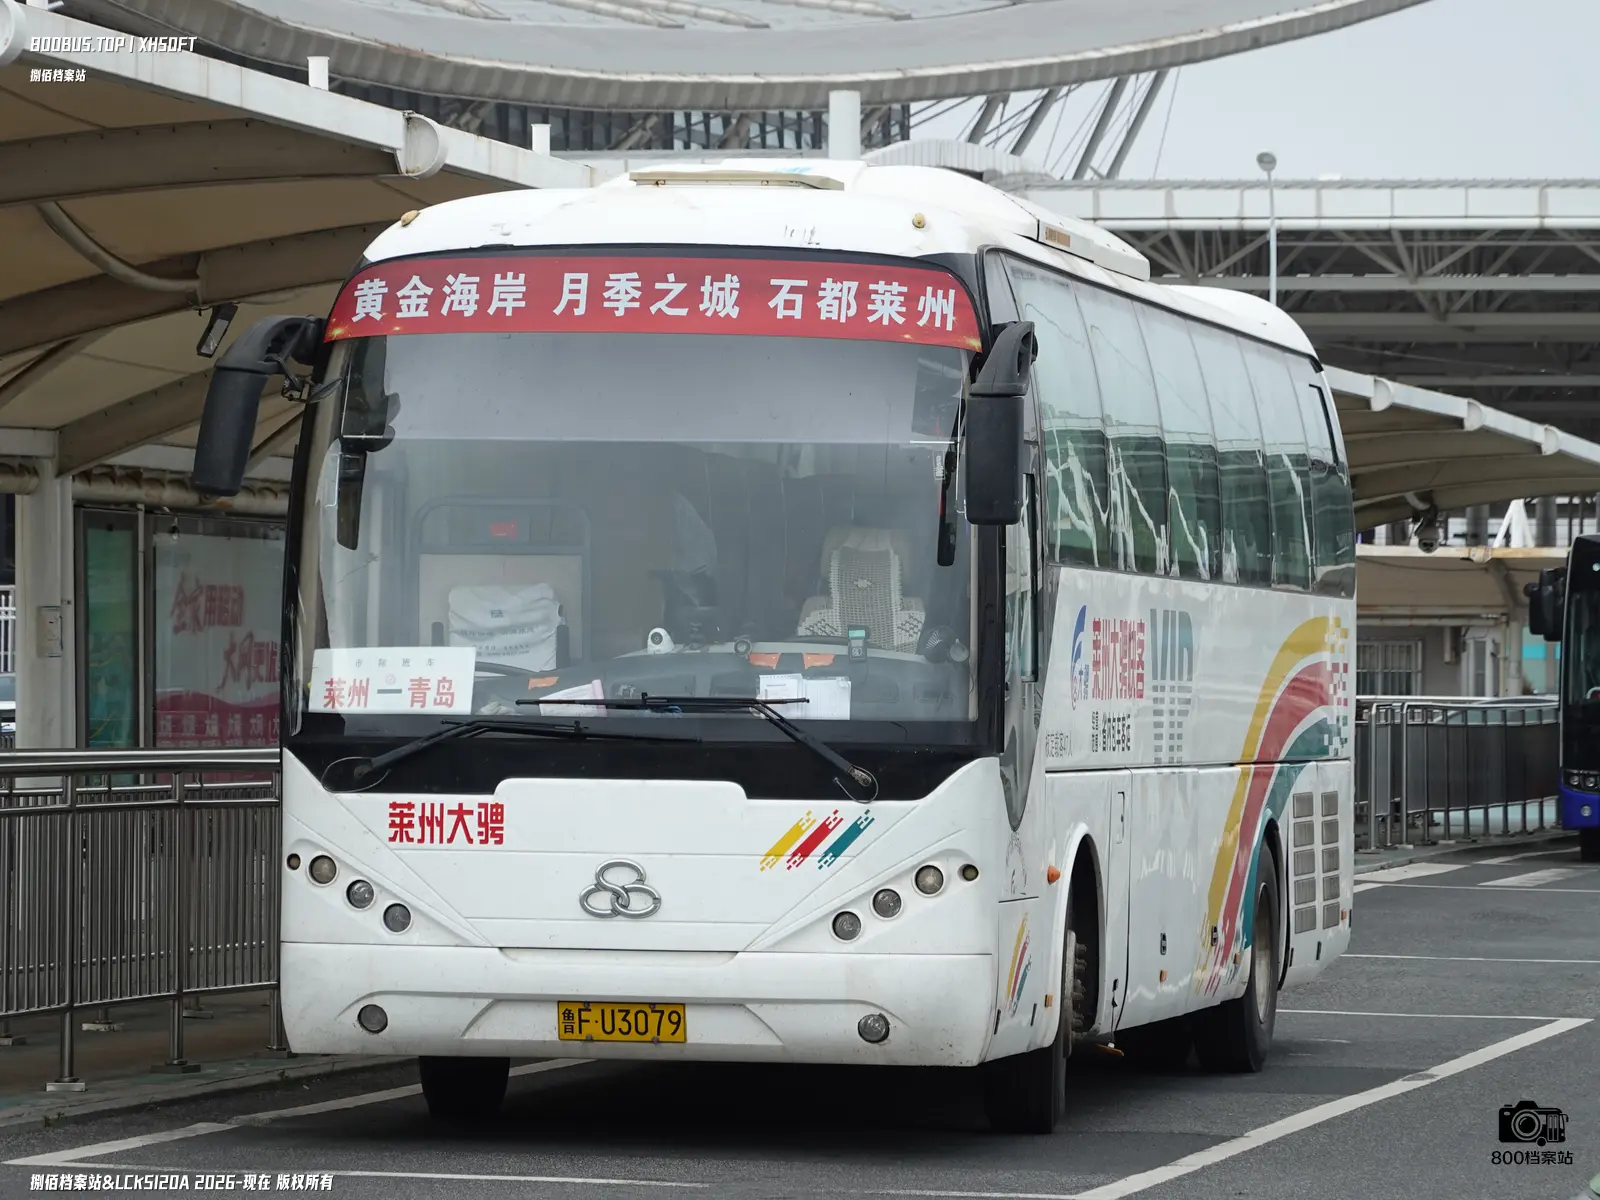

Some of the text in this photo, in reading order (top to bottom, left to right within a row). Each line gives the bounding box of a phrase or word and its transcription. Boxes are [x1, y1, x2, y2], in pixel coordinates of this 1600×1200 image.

[351, 271, 957, 332] 黄金海岸 月季之城 石都莱州
[388, 802, 505, 845] 莱州大骋
